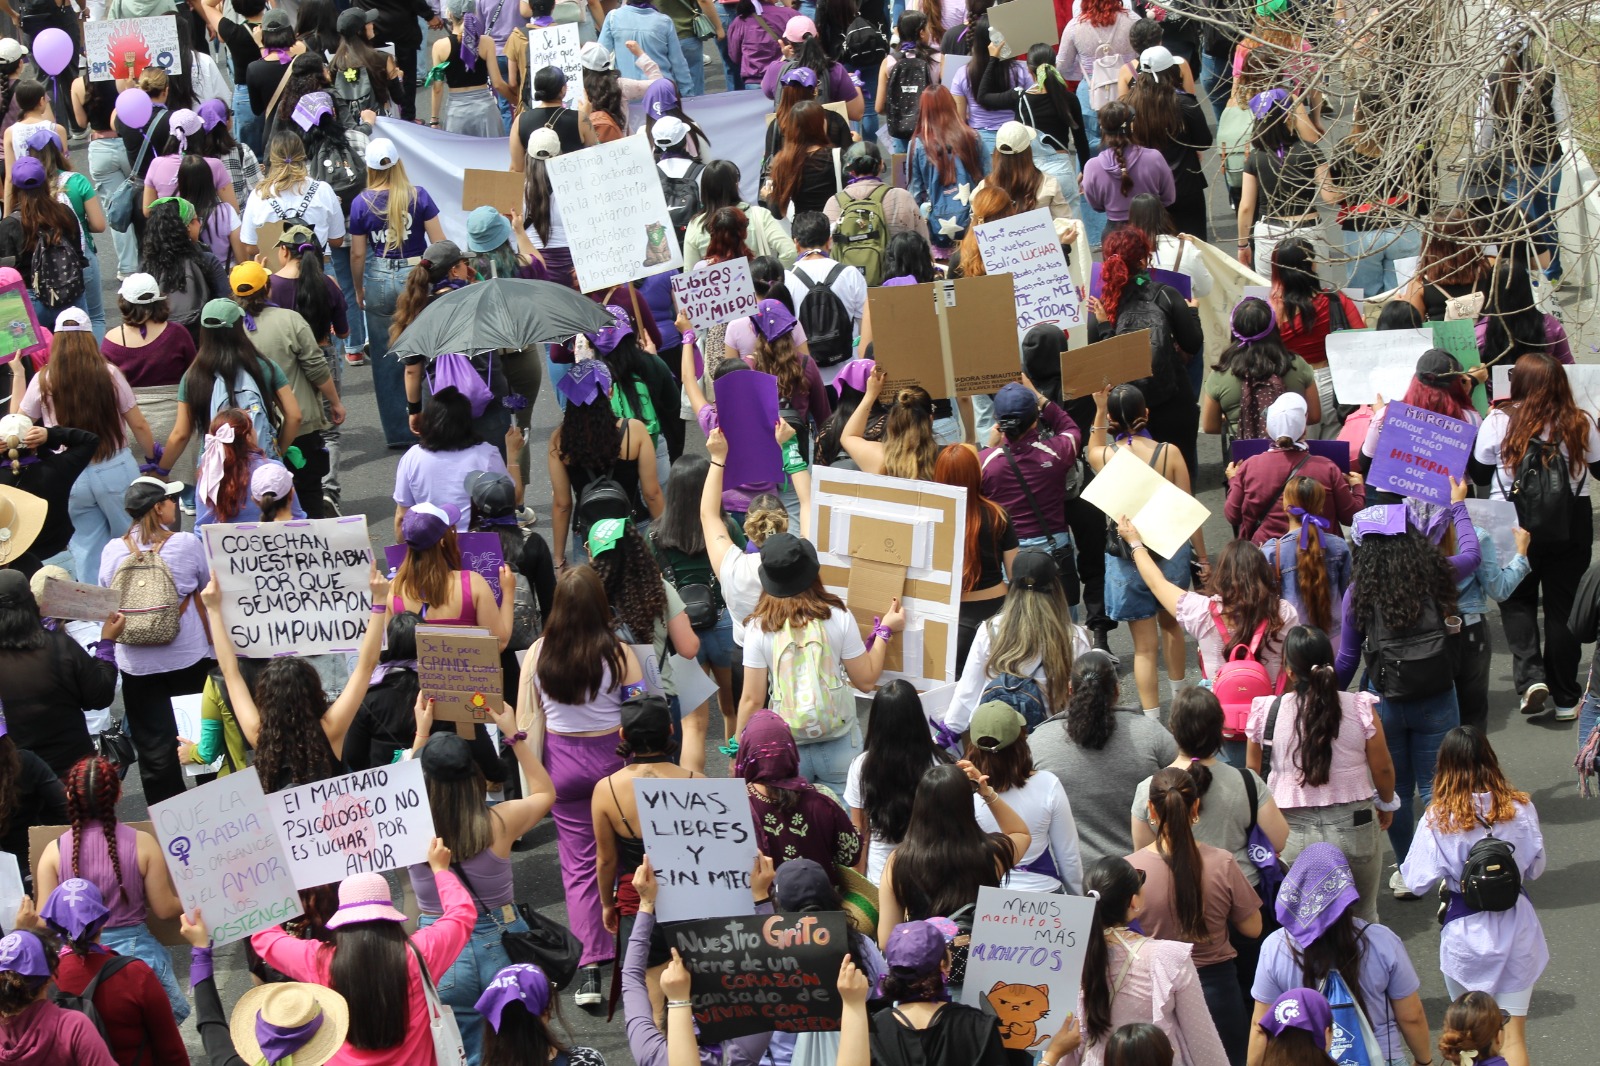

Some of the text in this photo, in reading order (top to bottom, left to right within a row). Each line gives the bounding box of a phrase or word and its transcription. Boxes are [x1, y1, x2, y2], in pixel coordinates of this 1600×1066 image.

[543, 28, 567, 50] Se la
[609, 145, 632, 165] que
[304, 181, 320, 205] PARIS
[558, 181, 569, 195] ni
[575, 176, 584, 191] el
[563, 205, 574, 215] ni
[578, 197, 589, 209] la
[566, 199, 652, 234] te quitaron lo
[586, 243, 635, 263] misógino
[1020, 243, 1058, 261] LUCHAR
[580, 275, 588, 288] y
[1037, 295, 1051, 306] por
[1052, 283, 1073, 298] MI
[1017, 311, 1035, 329] OR
[955, 375, 980, 383] ADORA
[981, 371, 1022, 380] SEMIAUTOM
[1388, 416, 1424, 435] PORQUE
[1405, 407, 1463, 433] MARCHO
[1409, 434, 1442, 451] TENGO
[1412, 445, 1432, 457] UNA
[1390, 448, 1449, 476] HISTORIA
[1405, 467, 1427, 479] QUE
[1388, 475, 1439, 498] CONTAR
[222, 533, 329, 554] COSECHAN
[322, 549, 370, 569] RABIA
[255, 571, 346, 594] POR QUE
[238, 590, 373, 616] SEMBRARON
[231, 617, 371, 648] SU IMPUNIDA
[422, 638, 480, 656] Se te pone
[421, 656, 471, 673] GRANDE
[448, 674, 464, 683] pero
[469, 673, 488, 682] bien
[311, 769, 388, 803] MALTRATO
[642, 790, 731, 814] VIVAS
[160, 790, 246, 836] QUE LA
[282, 788, 420, 841] PSICOLOGICO NO
[195, 813, 261, 848] RABIA
[291, 843, 308, 861] ES
[377, 816, 407, 839] POR
[650, 820, 748, 844] LIBRES
[174, 834, 275, 881] NOS ORGANICE
[346, 843, 396, 876] AMOR
[685, 845, 705, 865] Y
[200, 887, 216, 903] EL
[221, 856, 287, 898] AMOR
[653, 869, 751, 890] SIN MIE
[223, 897, 259, 919] NOS
[1003, 897, 1061, 918] MENOS
[981, 913, 1062, 928] machitos
[1034, 928, 1076, 947] MÁS
[740, 951, 765, 973] de
[767, 956, 800, 971] un
[972, 943, 1063, 971] MICHITOS
[721, 970, 821, 989] CORAZÓN
[692, 988, 830, 1009] cansado de
[695, 1005, 757, 1025] VIVIR
[775, 1016, 841, 1032] MIED
